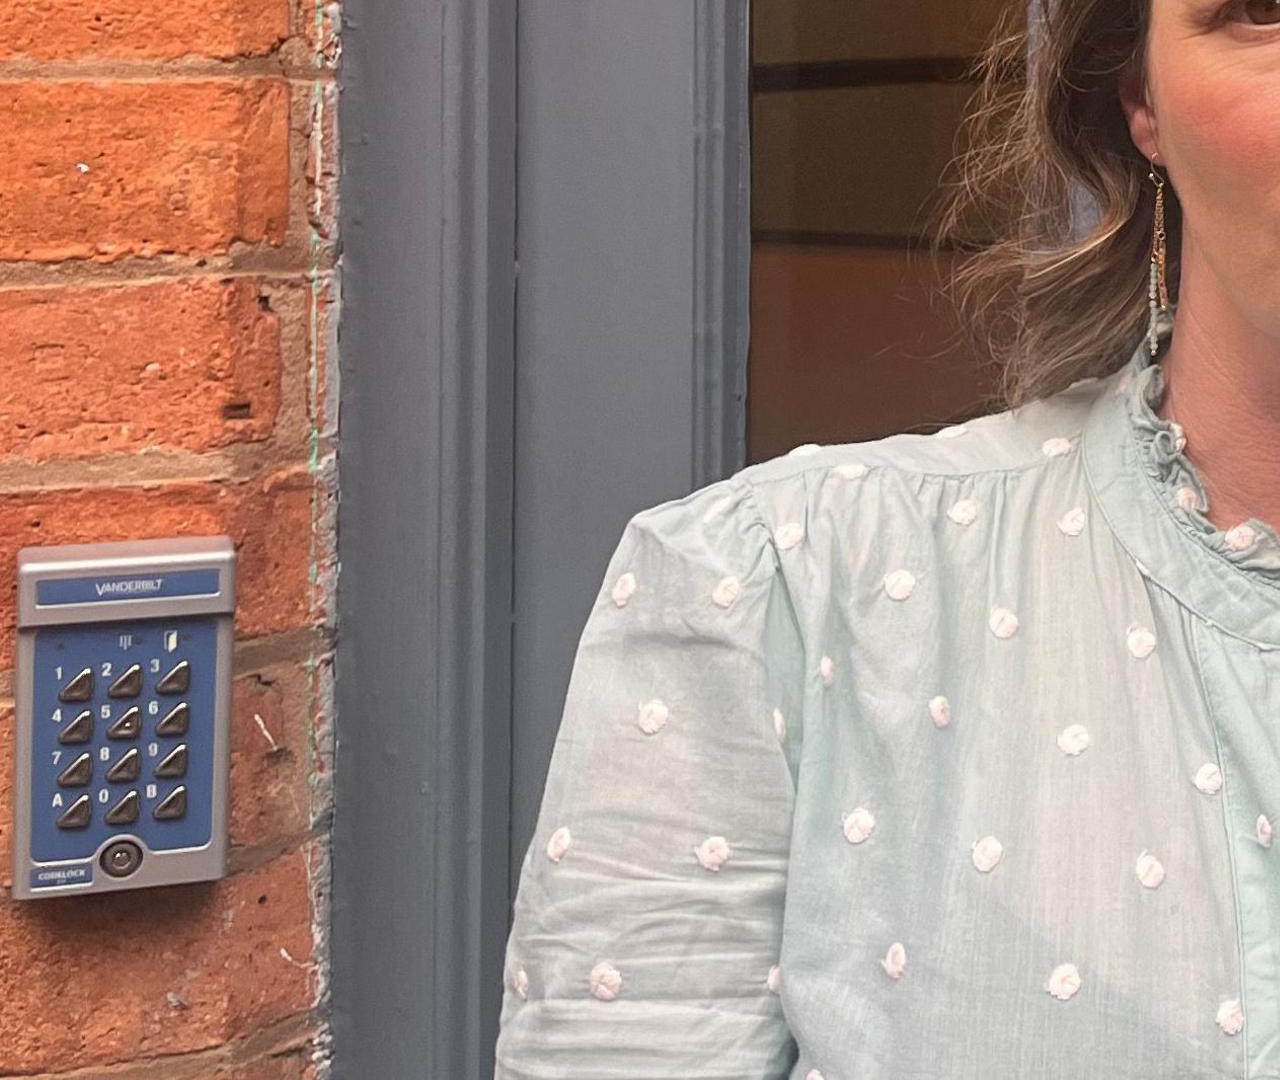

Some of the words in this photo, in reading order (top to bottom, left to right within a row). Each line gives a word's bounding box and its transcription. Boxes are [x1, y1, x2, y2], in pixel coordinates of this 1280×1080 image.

[95, 579, 163, 596] VANDERBILT
[55, 666, 63, 680] 1
[101, 662, 112, 677] 2
[150, 658, 160, 673] 3
[51, 708, 62, 722] 4
[101, 704, 111, 719] 5
[148, 700, 159, 715] 6
[52, 750, 62, 765] 7
[100, 746, 110, 761] 8
[148, 742, 158, 757] 9
[52, 792, 63, 808] A
[99, 788, 109, 804] 0
